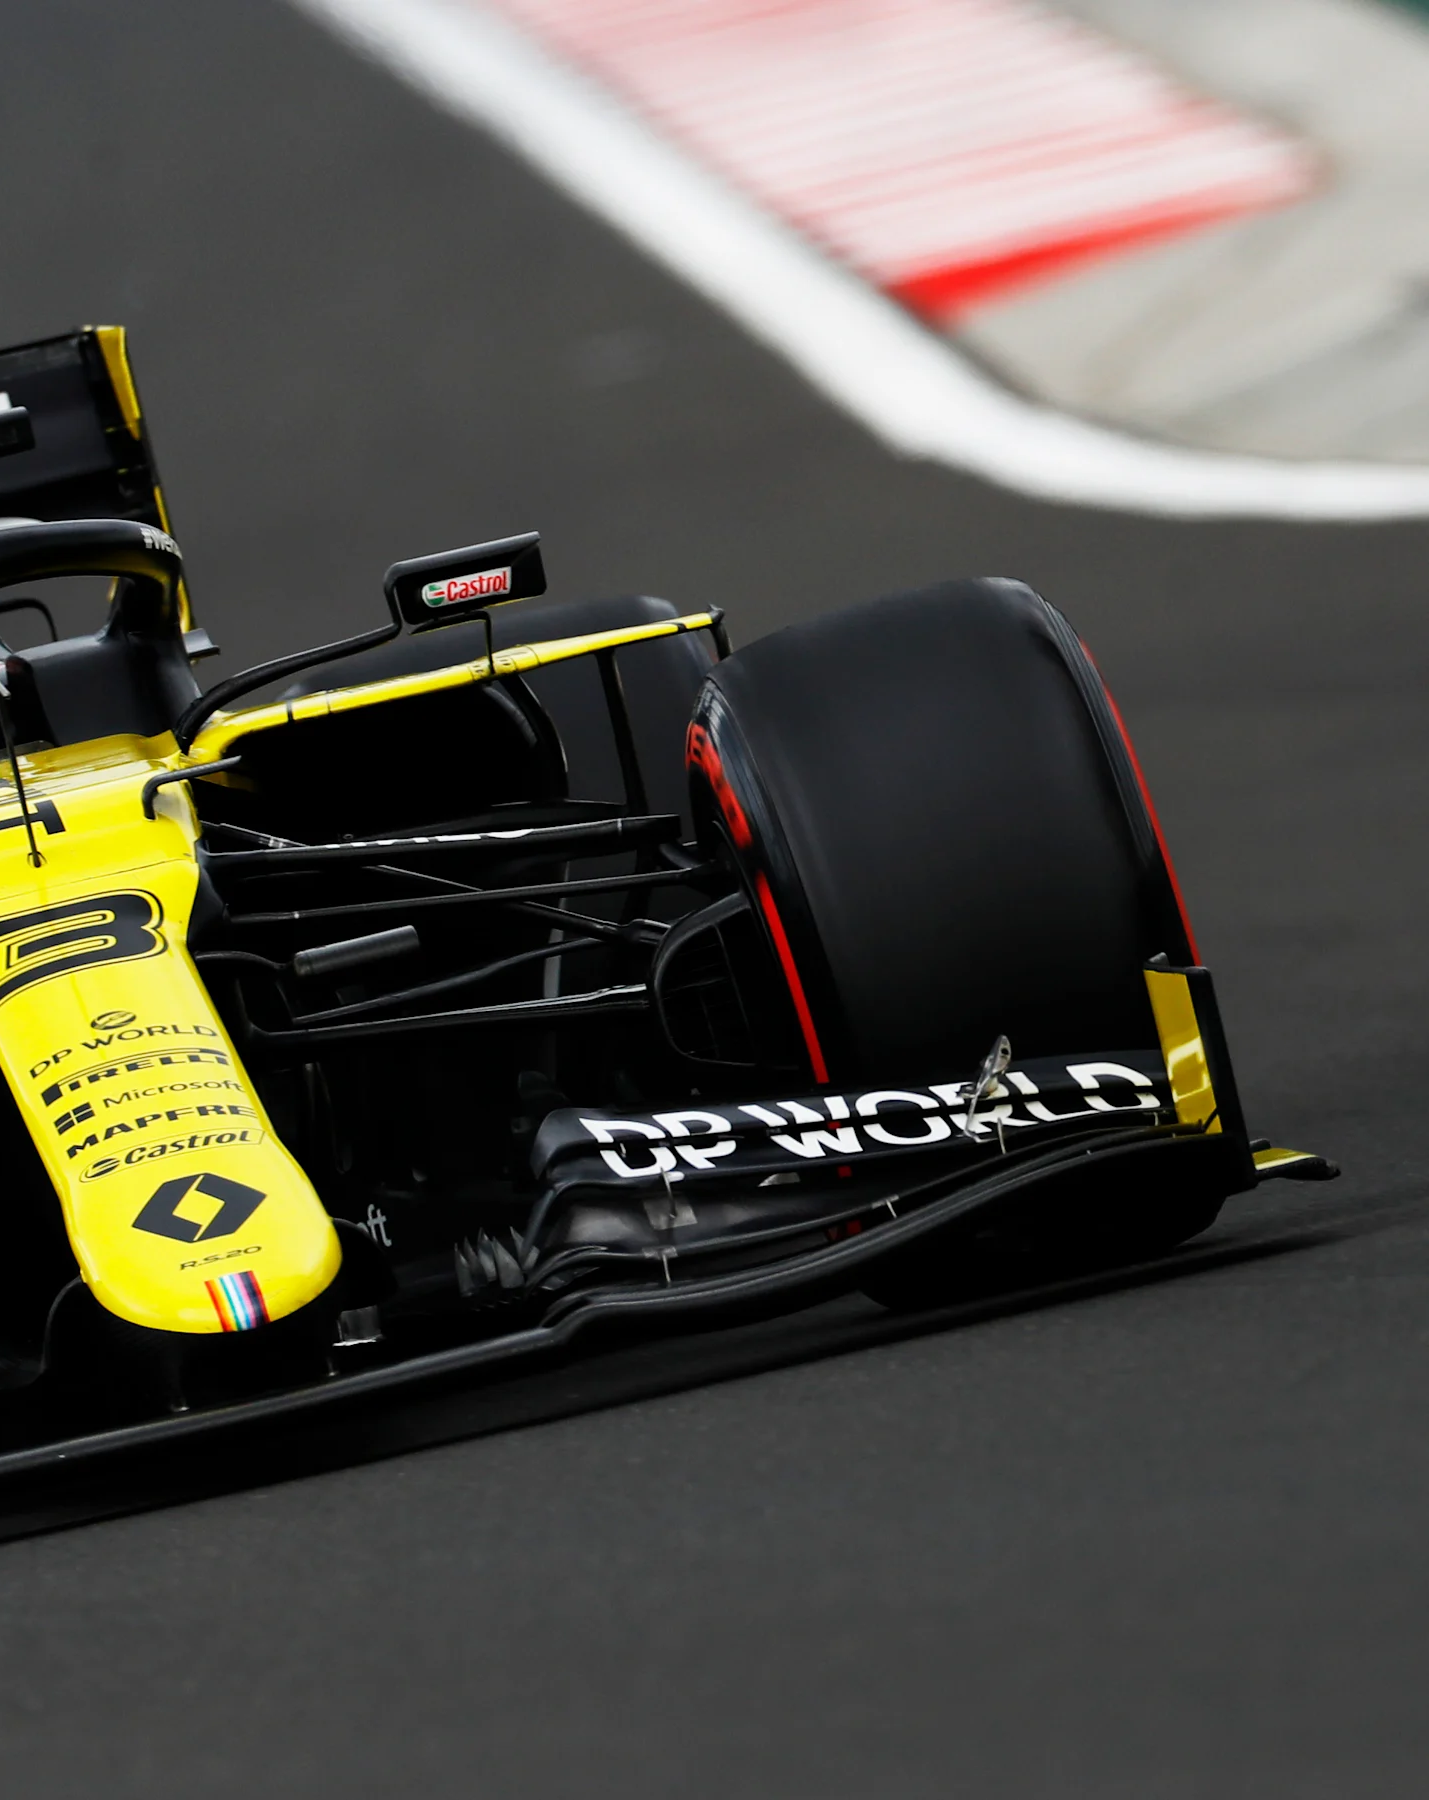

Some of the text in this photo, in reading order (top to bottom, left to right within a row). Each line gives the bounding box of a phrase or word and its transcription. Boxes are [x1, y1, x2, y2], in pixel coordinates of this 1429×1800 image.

[446, 570, 509, 602] Castrol
[29, 1023, 218, 1080] DP WORLD
[40, 1047, 230, 1108] PIRELLI
[102, 1079, 247, 1109] Microsoft
[66, 1103, 260, 1160] MAPFRE
[579, 1061, 1161, 1178] DP WORLD
[124, 1130, 255, 1165] Castrol
[179, 1246, 263, 1271] R.S.20
